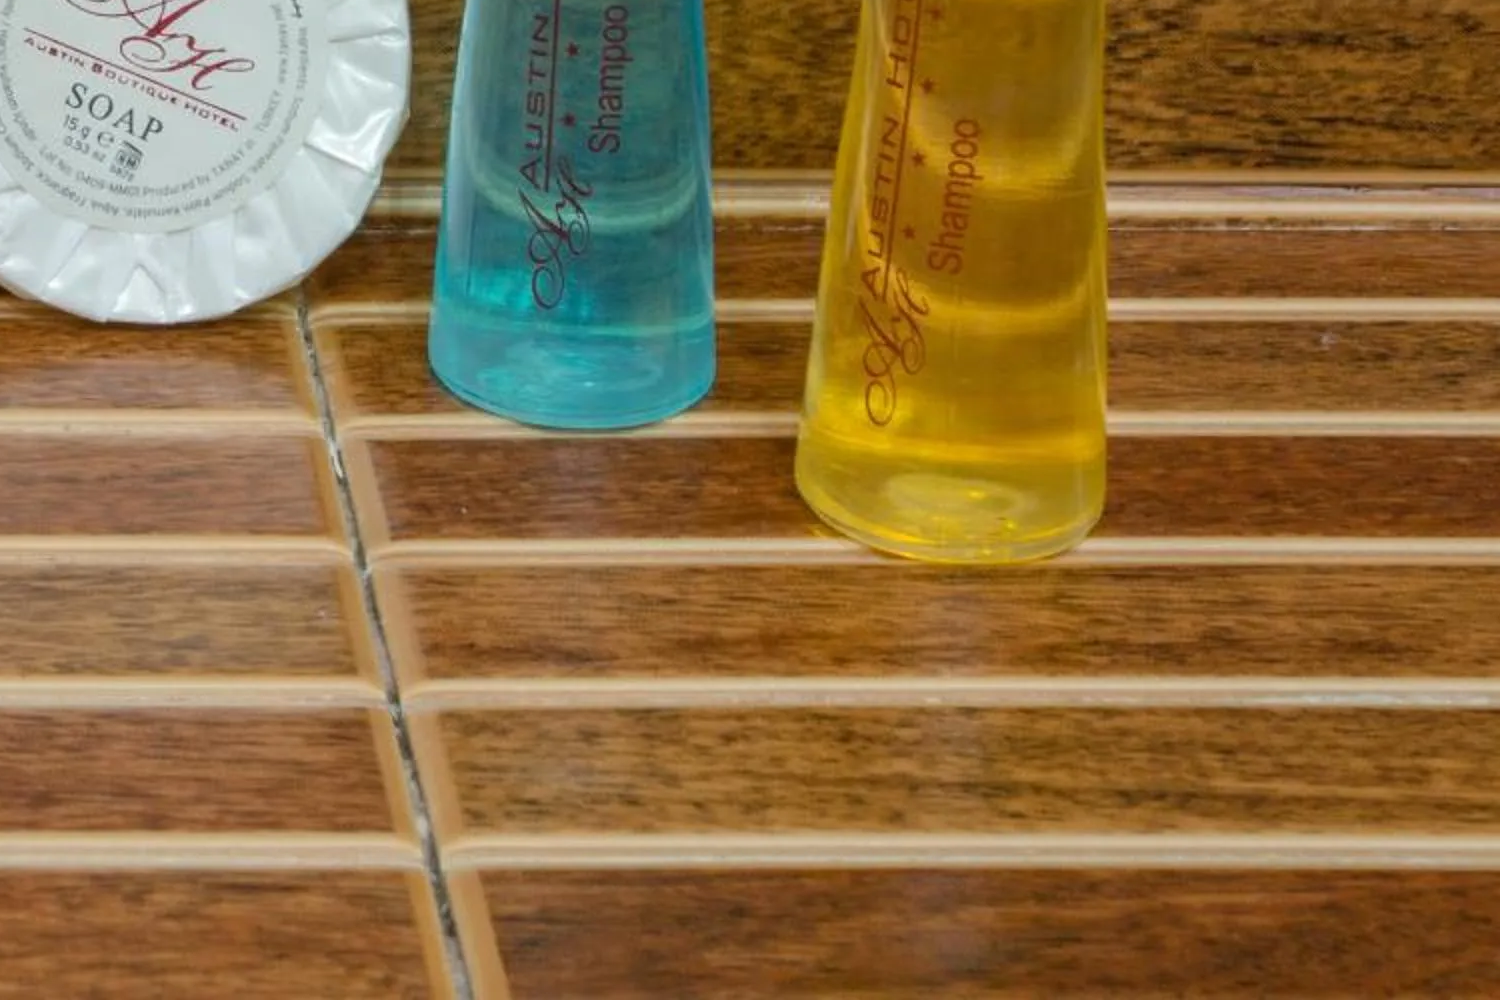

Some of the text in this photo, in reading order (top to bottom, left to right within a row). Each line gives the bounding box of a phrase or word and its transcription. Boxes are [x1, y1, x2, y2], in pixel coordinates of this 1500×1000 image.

[23, 37, 239, 132] AUSTIN BOUTIQUE HOTEL
[65, 82, 164, 142] SOAP
[519, 15, 549, 191] AUSTIN
[588, 4, 635, 155] Shampoo
[860, 117, 899, 300] AUSTIN
[926, 118, 984, 275] Shampoo
